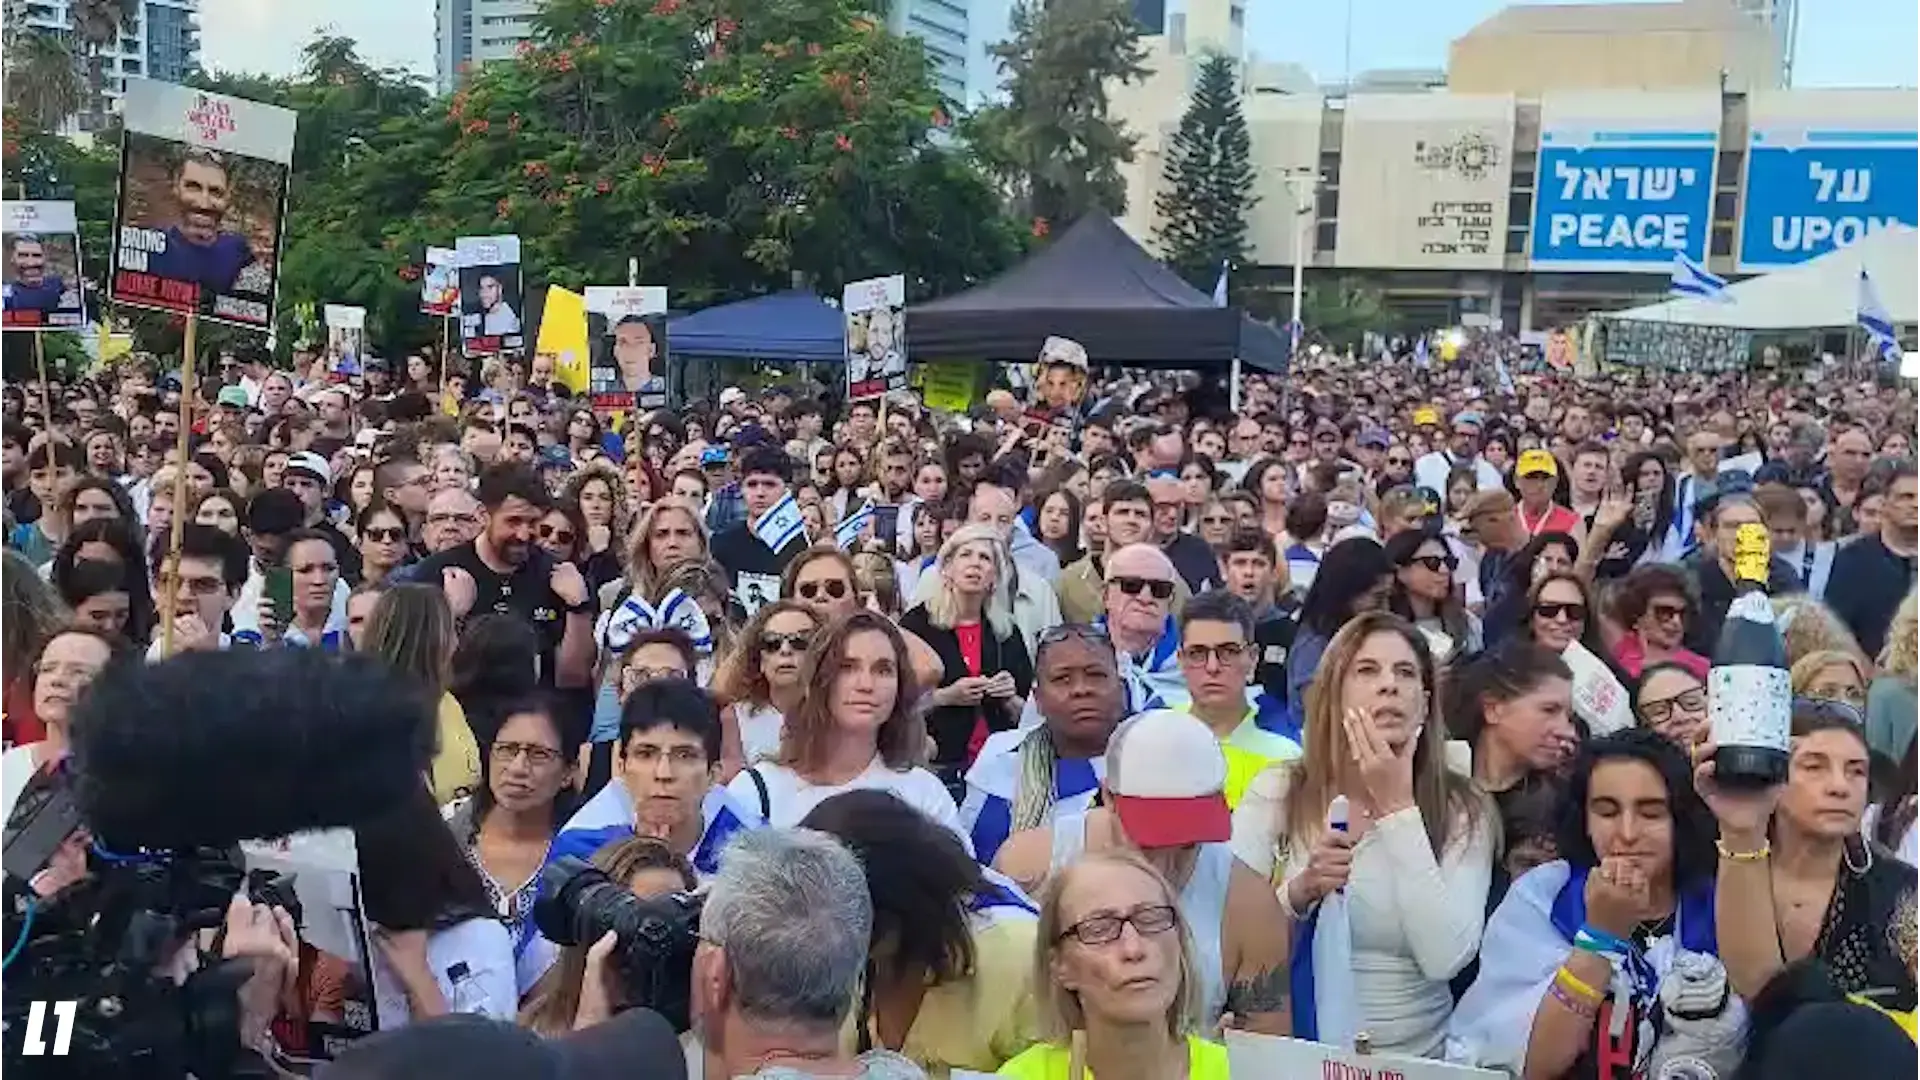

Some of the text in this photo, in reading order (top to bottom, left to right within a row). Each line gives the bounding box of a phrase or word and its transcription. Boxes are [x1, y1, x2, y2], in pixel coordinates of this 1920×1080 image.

[1555, 160, 1695, 201] ישראל
[1808, 161, 1871, 203] על
[120, 224, 167, 255] BRING
[1550, 213, 1690, 250] PEACE
